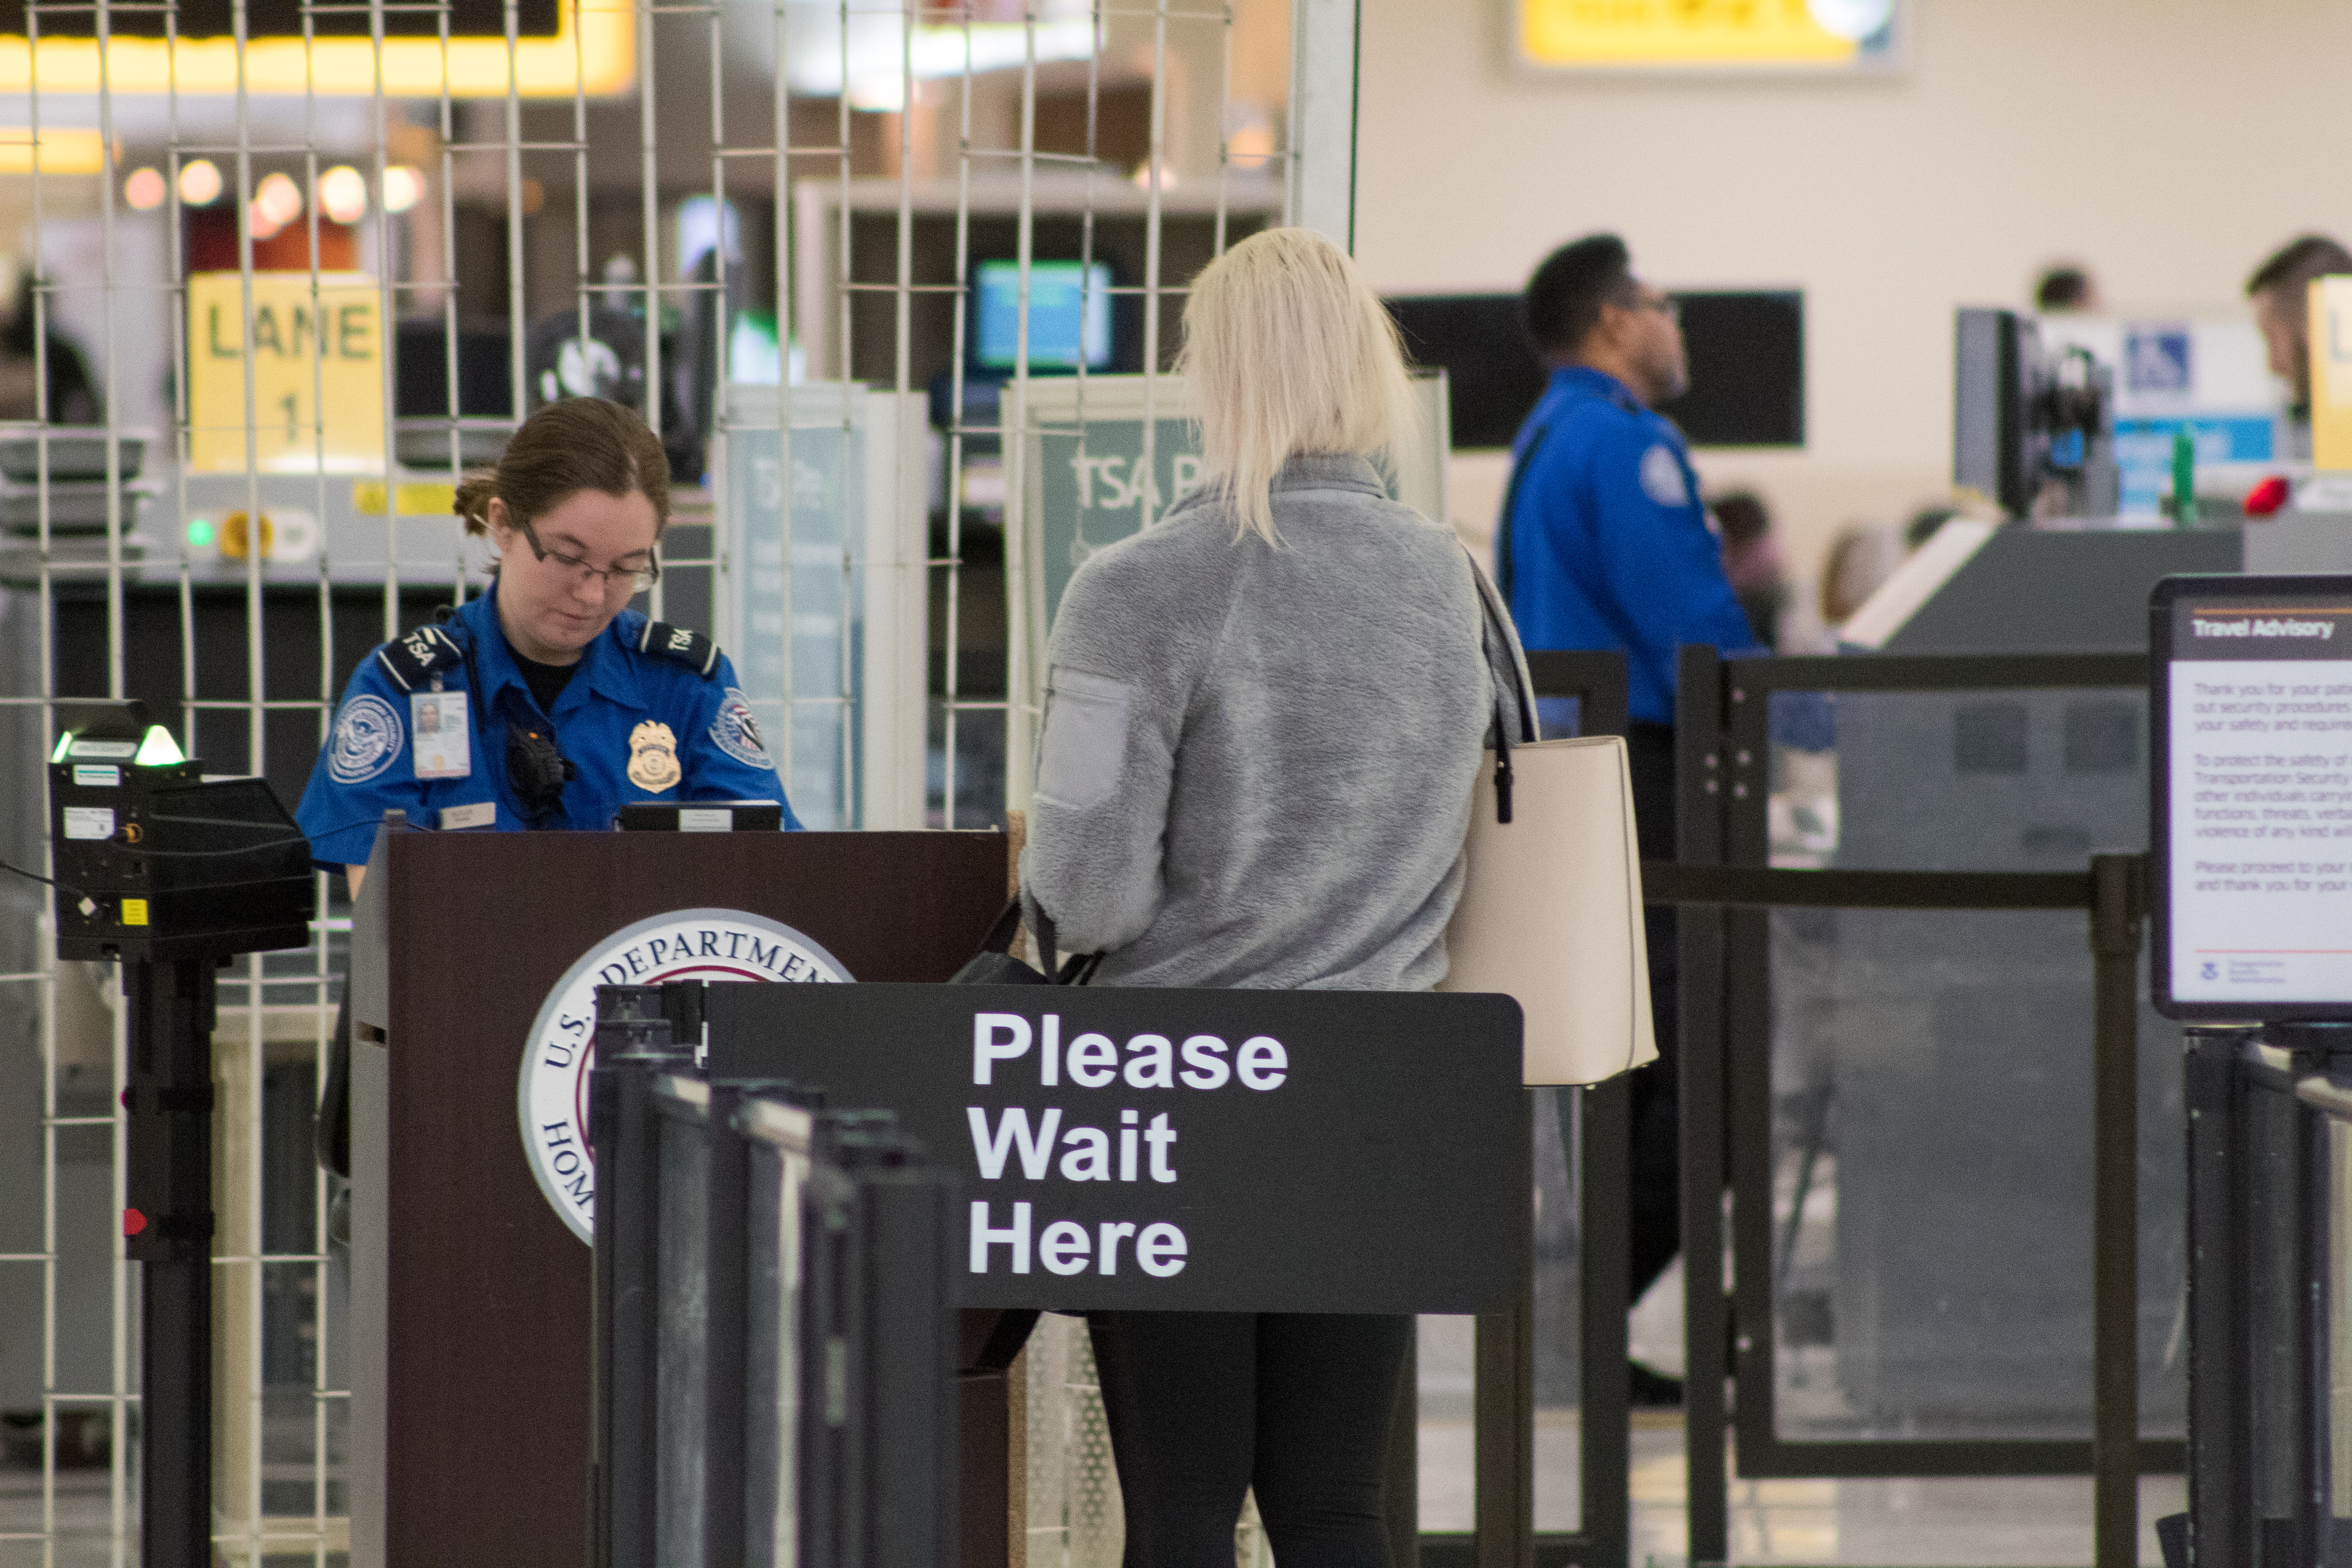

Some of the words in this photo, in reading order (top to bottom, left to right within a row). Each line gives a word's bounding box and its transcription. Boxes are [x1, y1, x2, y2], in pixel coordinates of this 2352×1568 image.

[209, 302, 372, 359] LANE
[279, 393, 298, 445] 1
[1070, 455, 1161, 509] TSA
[1174, 455, 1202, 499] P
[402, 631, 436, 666] TSA
[668, 628, 693, 650] TSA
[2193, 618, 2249, 637] Travel
[2253, 618, 2334, 639] Advisory
[545, 1014, 591, 1068] U.S.
[598, 930, 829, 985] DEPARTME
[973, 1012, 1289, 1091] Please
[543, 1120, 595, 1220] HOM
[966, 1107, 1177, 1183] Wait
[970, 1201, 1188, 1277] Here
